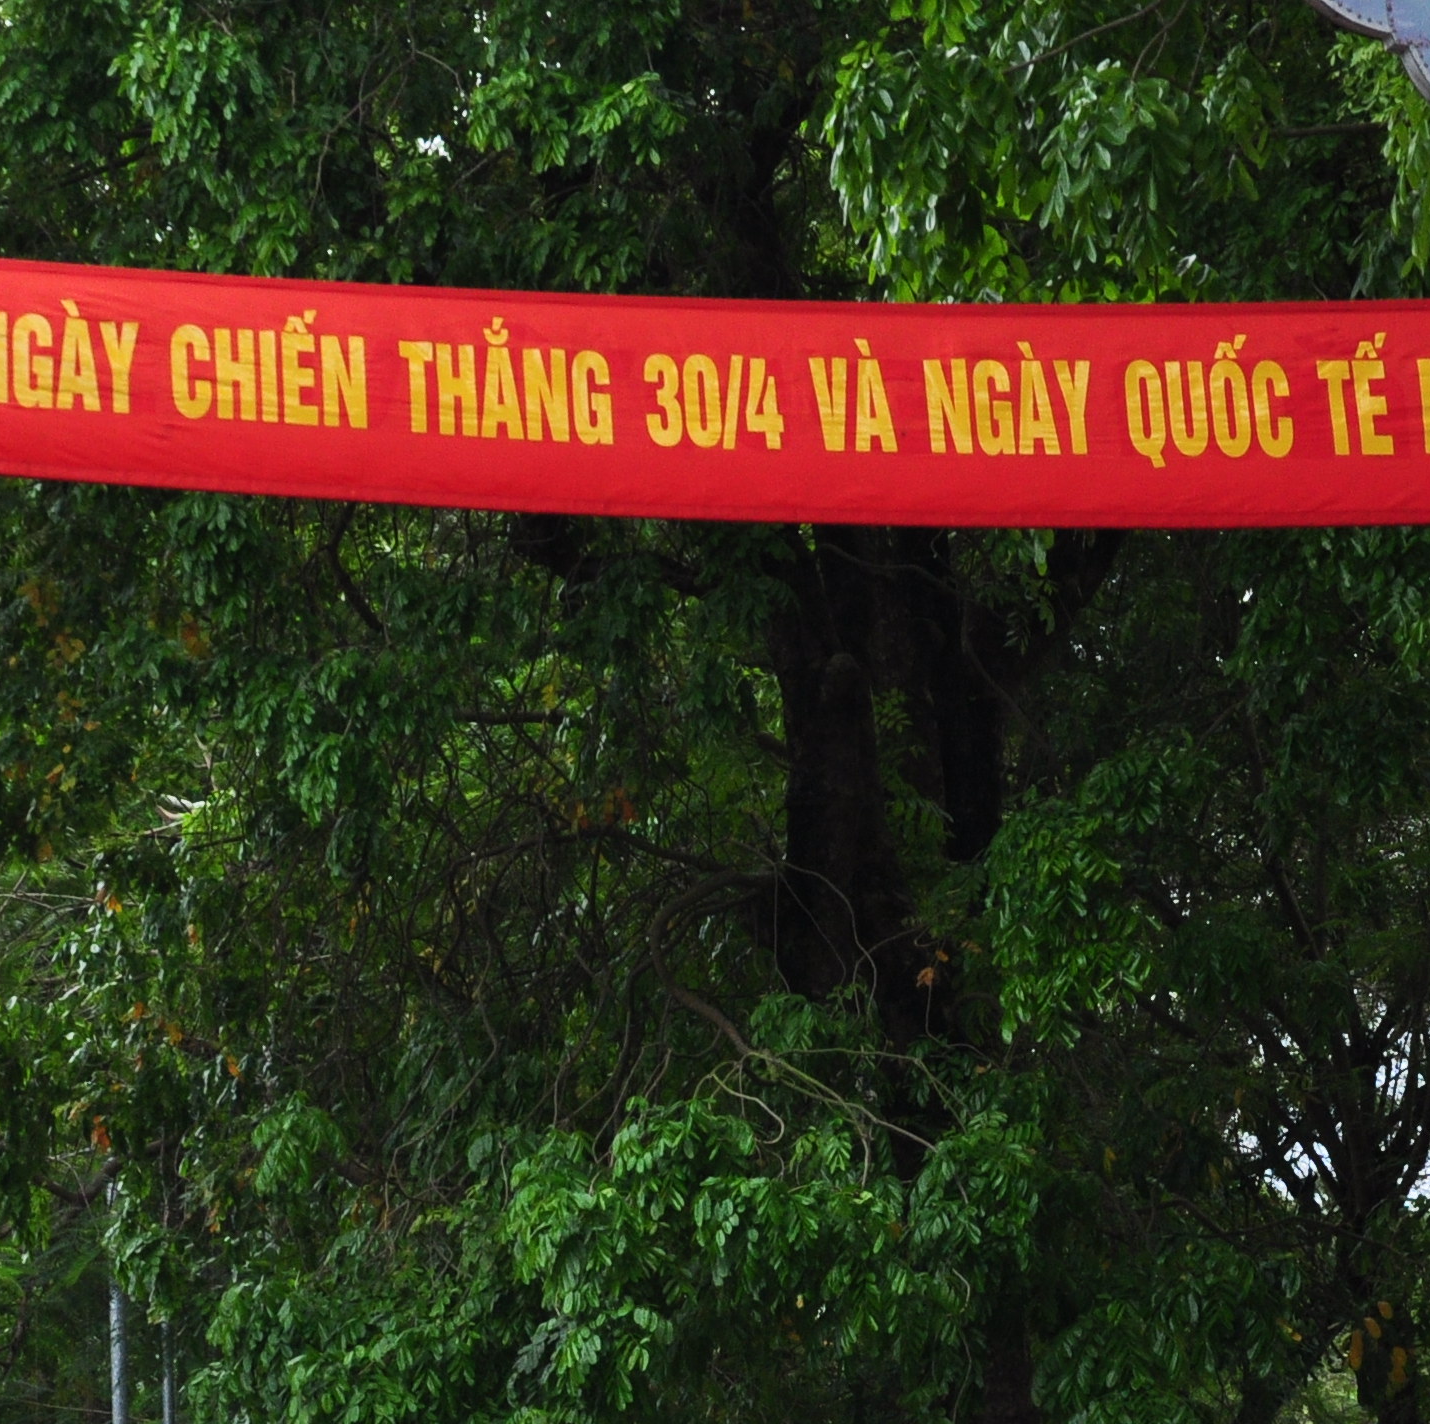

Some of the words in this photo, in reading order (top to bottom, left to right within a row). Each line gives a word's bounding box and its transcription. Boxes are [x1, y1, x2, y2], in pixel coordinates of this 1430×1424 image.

[171, 310, 368, 429] CHIẾN
[399, 317, 614, 445] THẮNG
[644, 354, 785, 450] 30/4
[809, 338, 898, 453] VÀ
[923, 341, 1091, 456] NGÀY
[1124, 334, 1294, 468] QUỐC
[1317, 332, 1395, 456] TẾ
